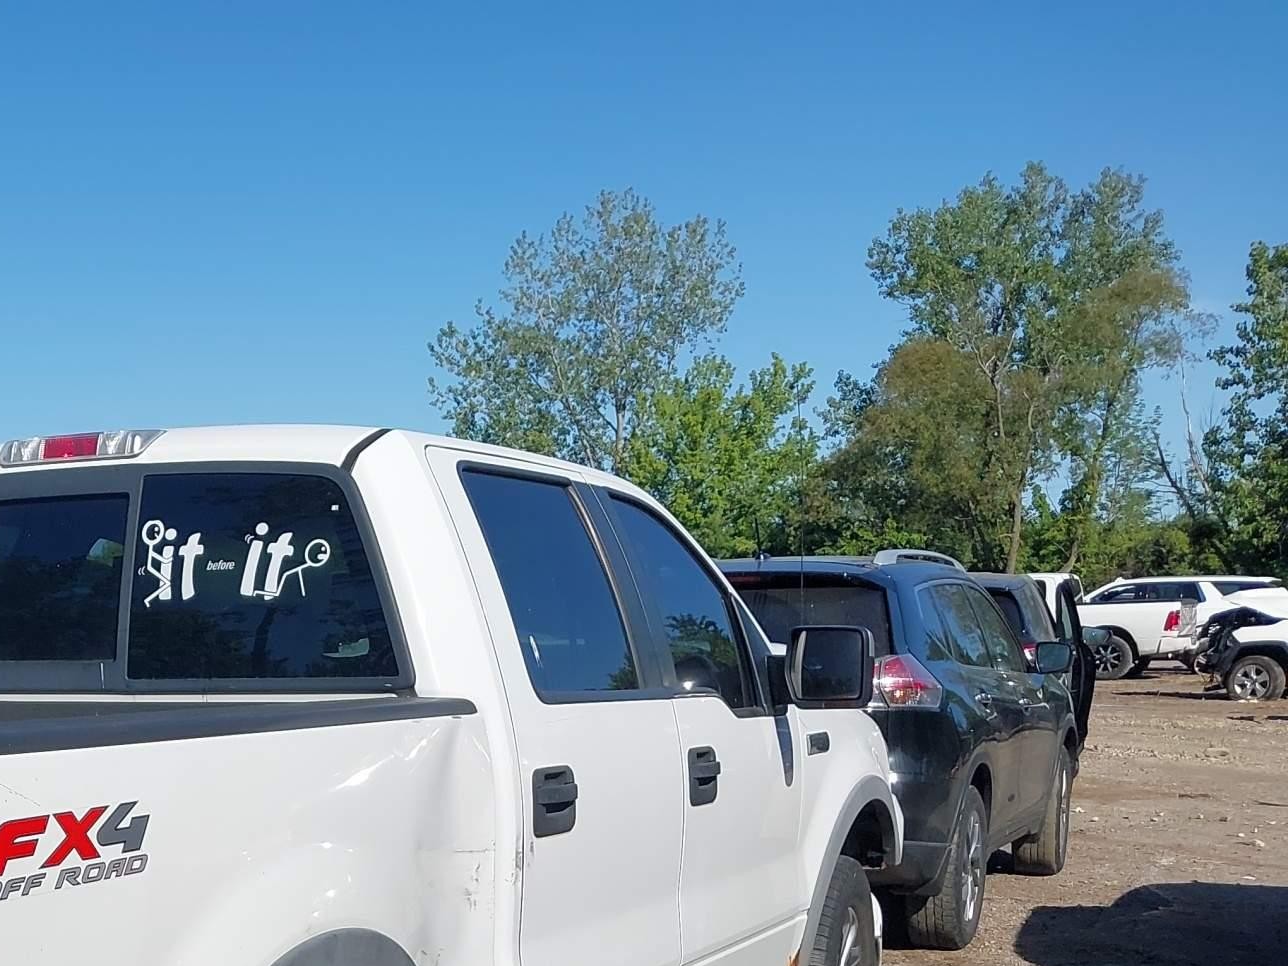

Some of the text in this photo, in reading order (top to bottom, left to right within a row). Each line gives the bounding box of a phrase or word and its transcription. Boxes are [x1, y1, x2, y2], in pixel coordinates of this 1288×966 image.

[206, 560, 236, 571] before
[240, 522, 294, 600] it
[54, 855, 149, 889] ROAD
